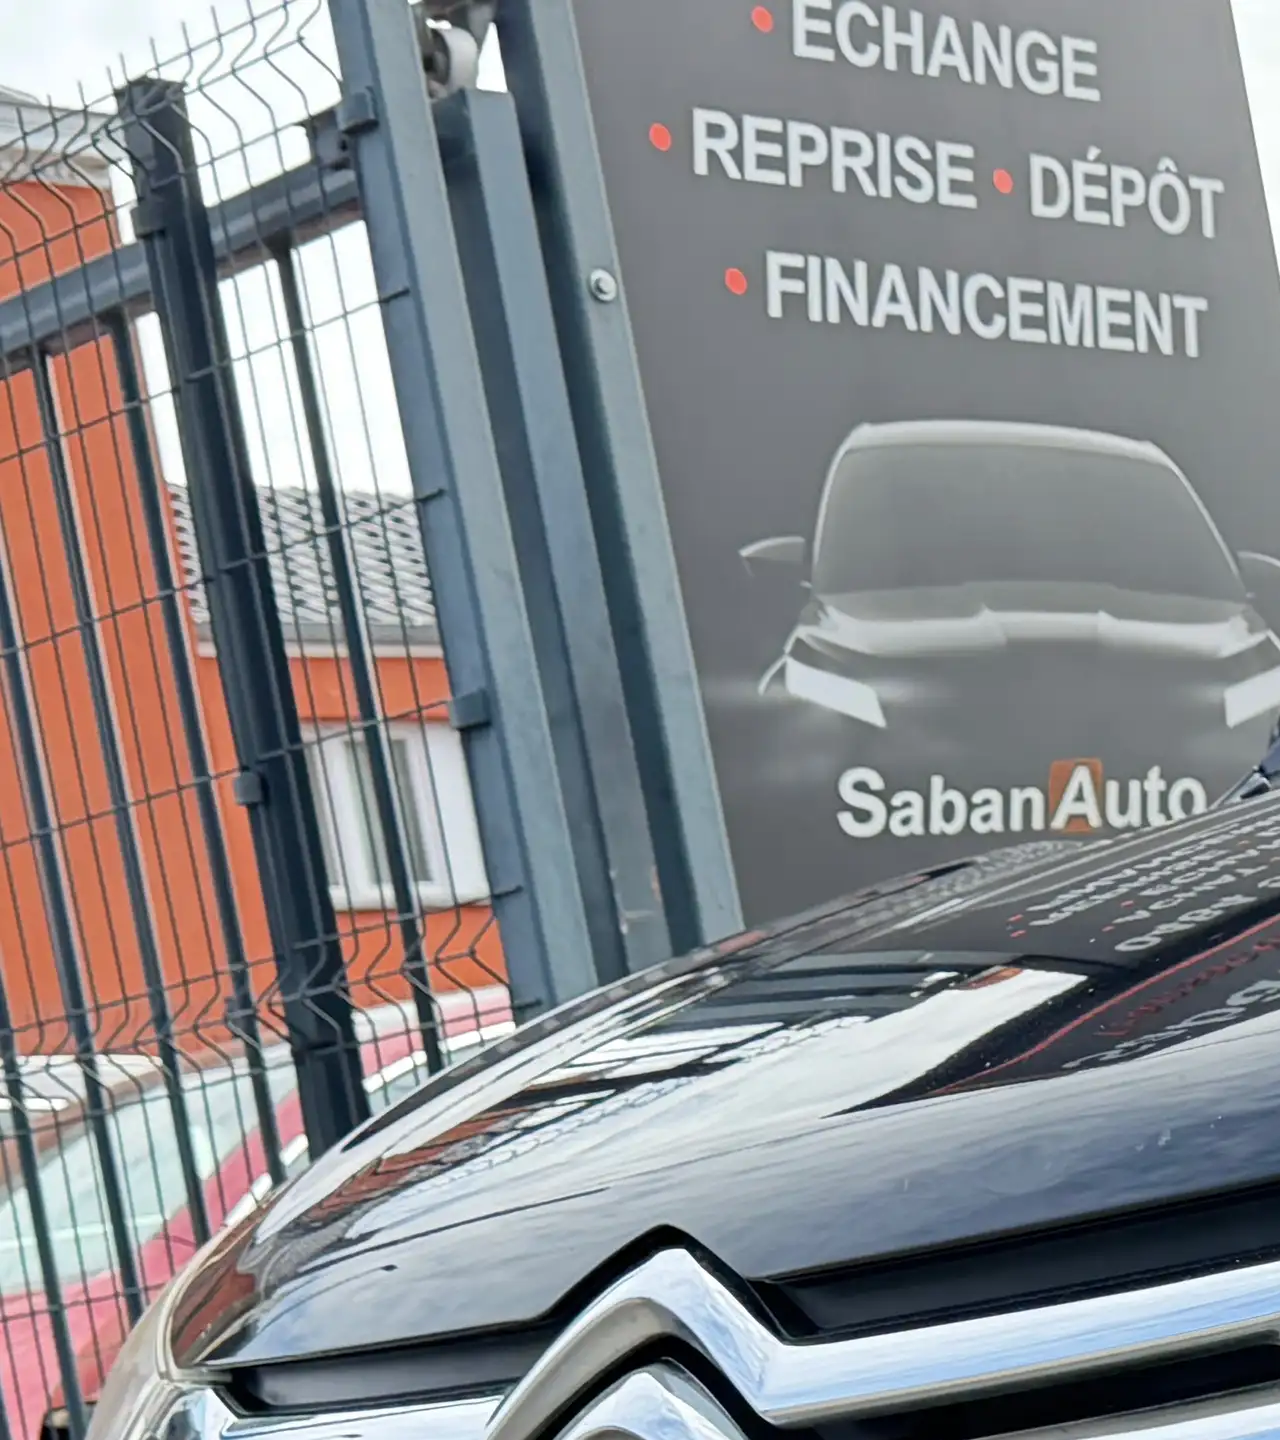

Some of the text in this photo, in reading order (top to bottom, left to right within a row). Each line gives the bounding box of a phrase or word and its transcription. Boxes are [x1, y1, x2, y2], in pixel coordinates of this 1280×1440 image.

[692, 107, 1224, 239] REPRISE DÉPÔT
[765, 250, 1209, 359] FINANCEMENT
[836, 760, 1208, 837] SabanAuto
